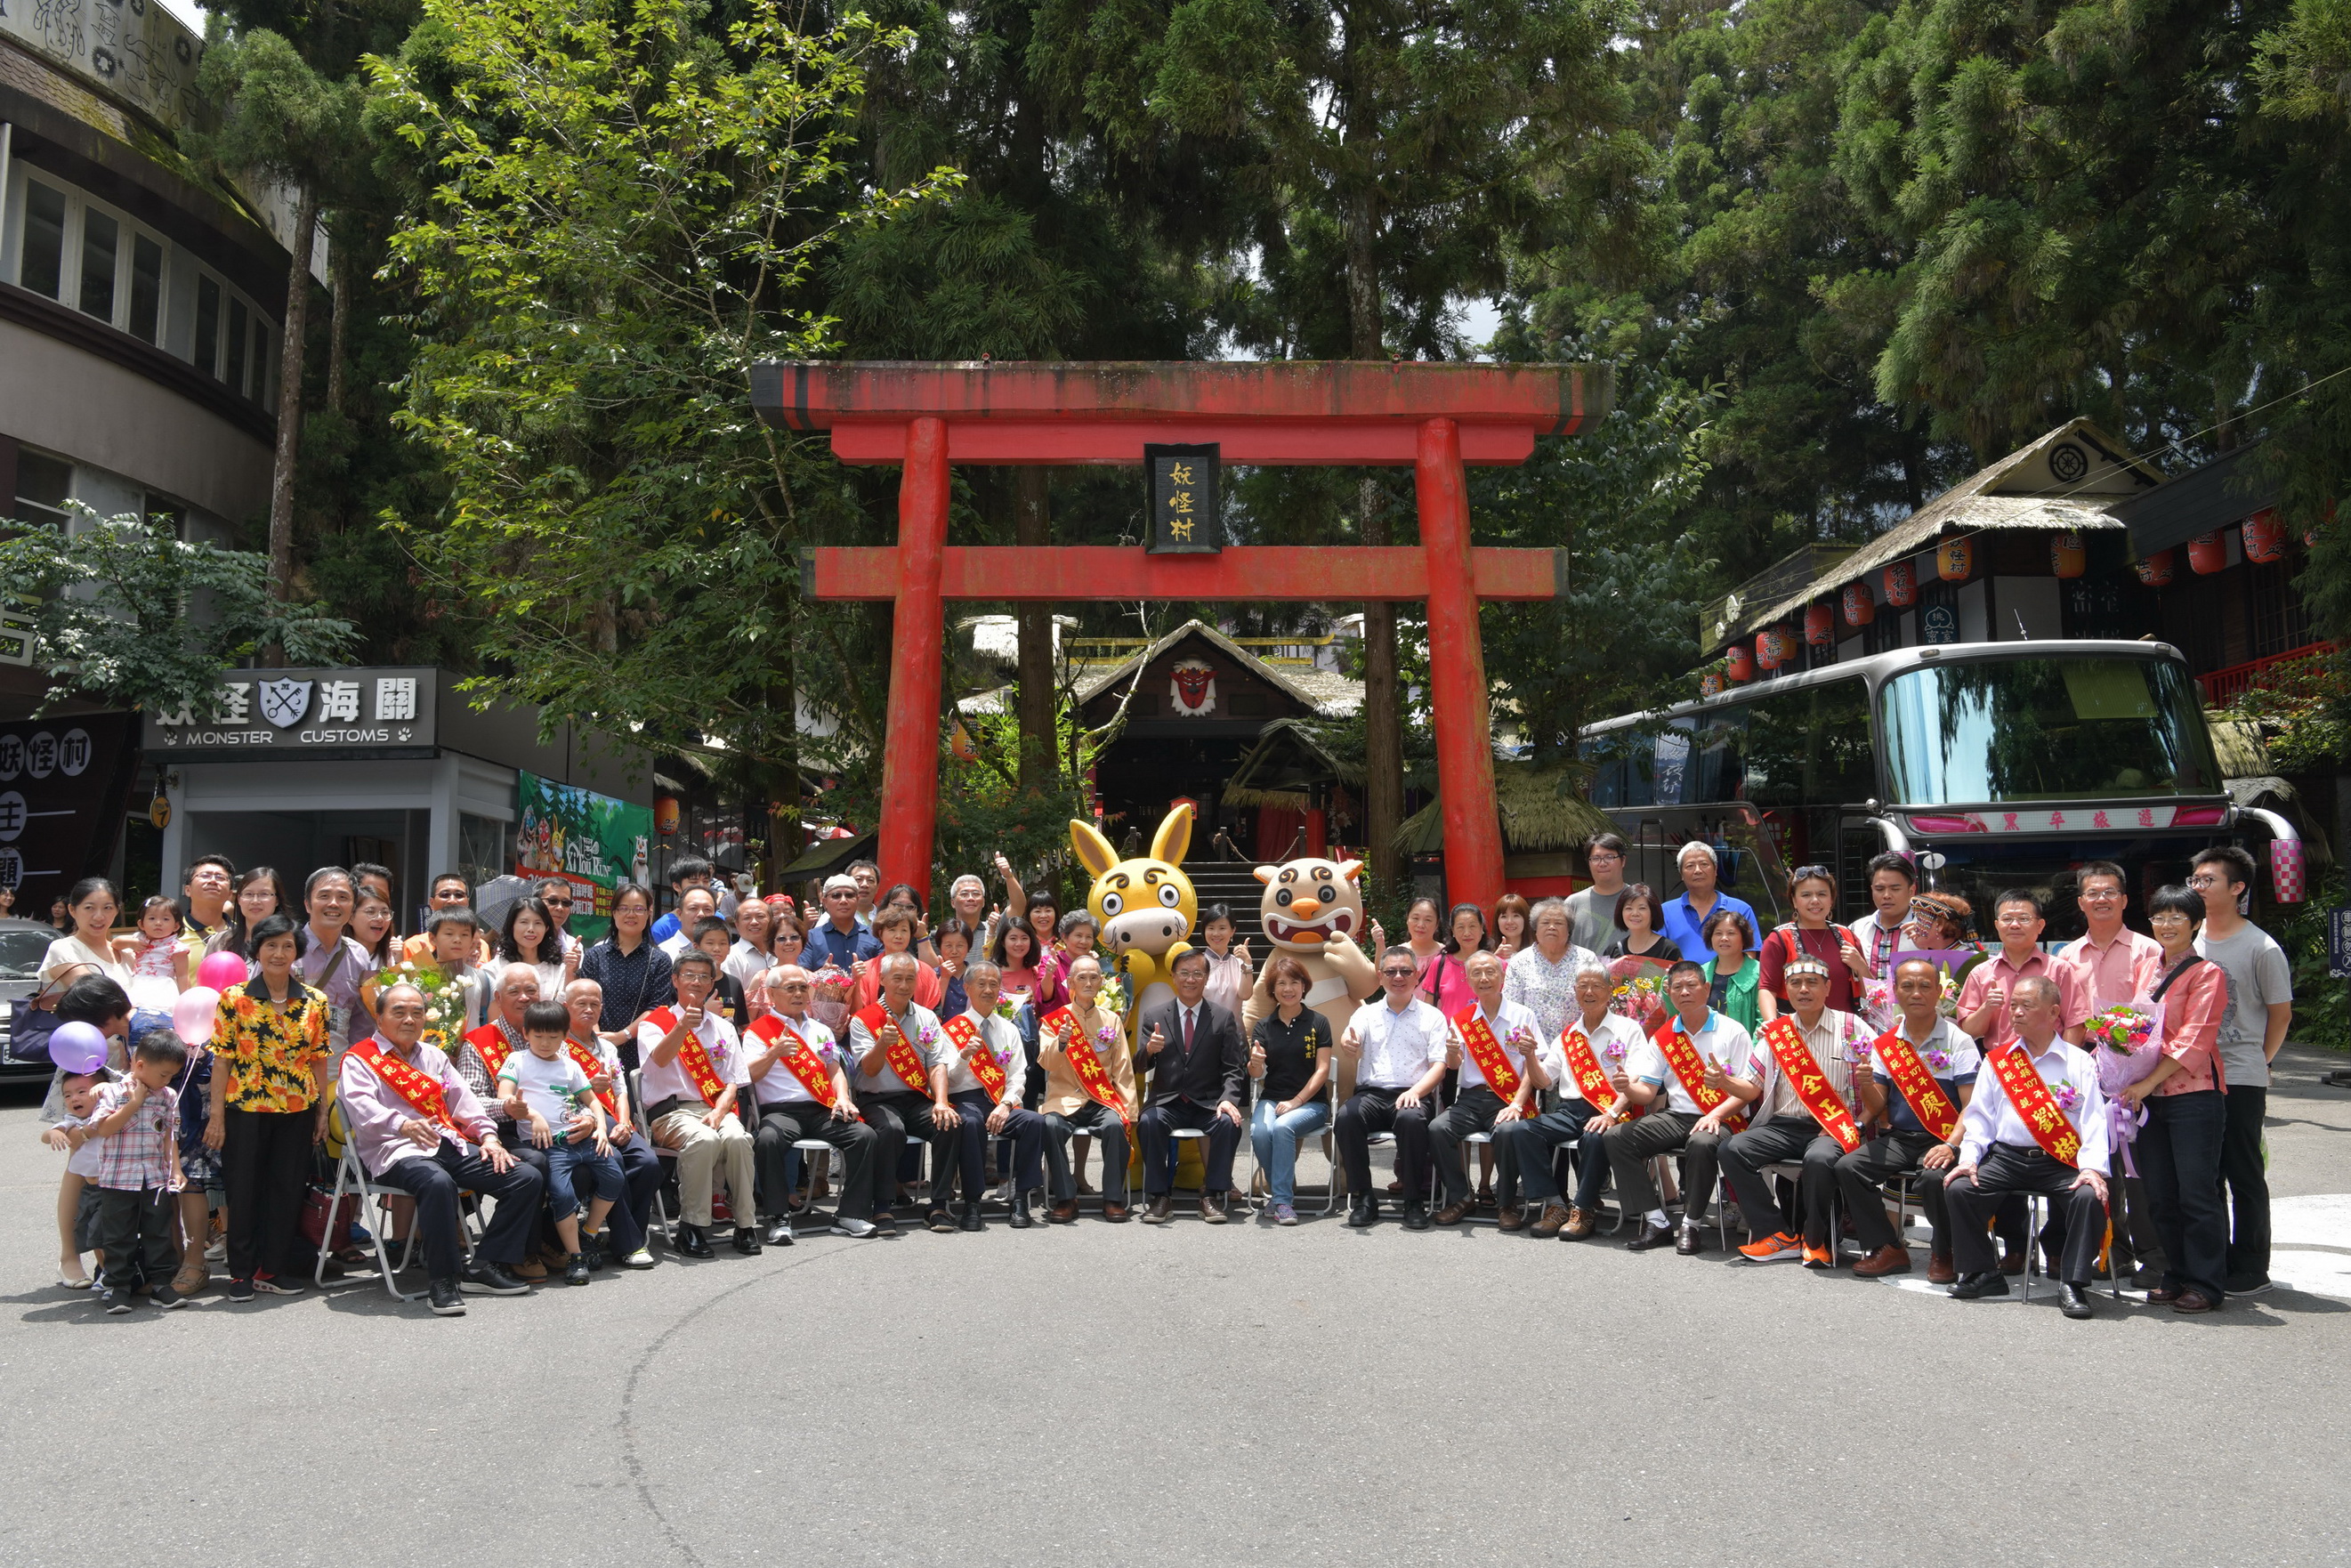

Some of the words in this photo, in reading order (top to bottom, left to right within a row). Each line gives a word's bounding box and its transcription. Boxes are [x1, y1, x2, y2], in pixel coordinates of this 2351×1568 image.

[1168, 462, 1195, 542] 妖怪村
[1926, 629, 1954, 643] 密室
[319, 677, 416, 723] 海關
[185, 731, 273, 745] MONSTER
[300, 729, 389, 743] CUSTOMS
[1665, 1043, 1696, 1087] 模範父親
[1769, 1031, 1800, 1076] 模範父親
[1781, 1024, 1810, 1067] 南投縣107年
[1895, 1039, 1928, 1087] 南投縣107年
[1882, 1046, 1919, 1096] 模範父親
[1996, 1058, 2033, 1110] 模範父親
[2010, 1051, 2045, 1100] 南投縣107年
